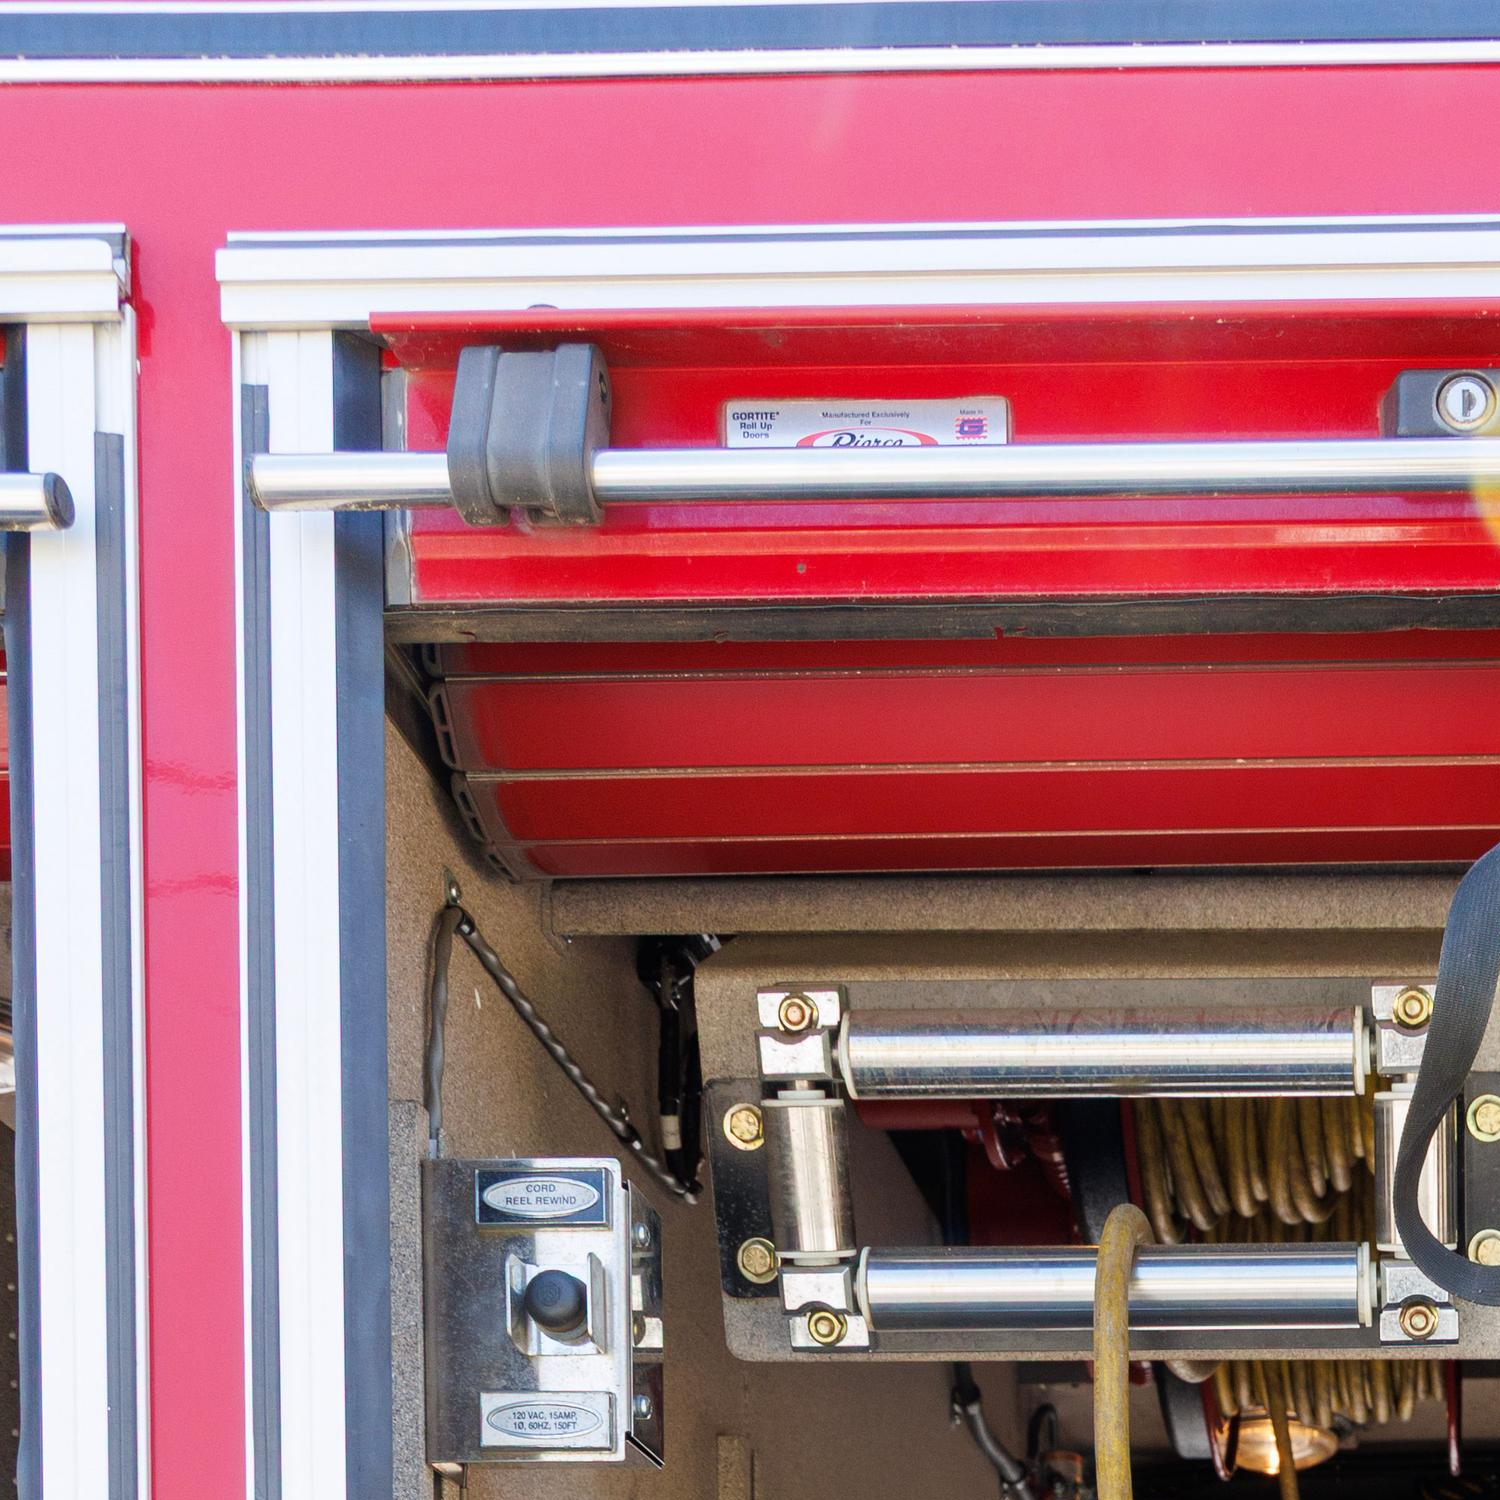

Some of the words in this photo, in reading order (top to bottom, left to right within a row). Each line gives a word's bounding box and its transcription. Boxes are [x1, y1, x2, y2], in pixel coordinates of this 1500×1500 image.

[740, 422, 757, 430] Roll
[760, 422, 773, 431] Up
[743, 431, 770, 439] Doors
[525, 1184, 556, 1193] CORD
[505, 1196, 533, 1205] REEL
[535, 1195, 577, 1205] REWIND
[512, 1411, 526, 1420] 120
[527, 1411, 547, 1421] VAC,
[554, 1421, 577, 1430] 150FT
